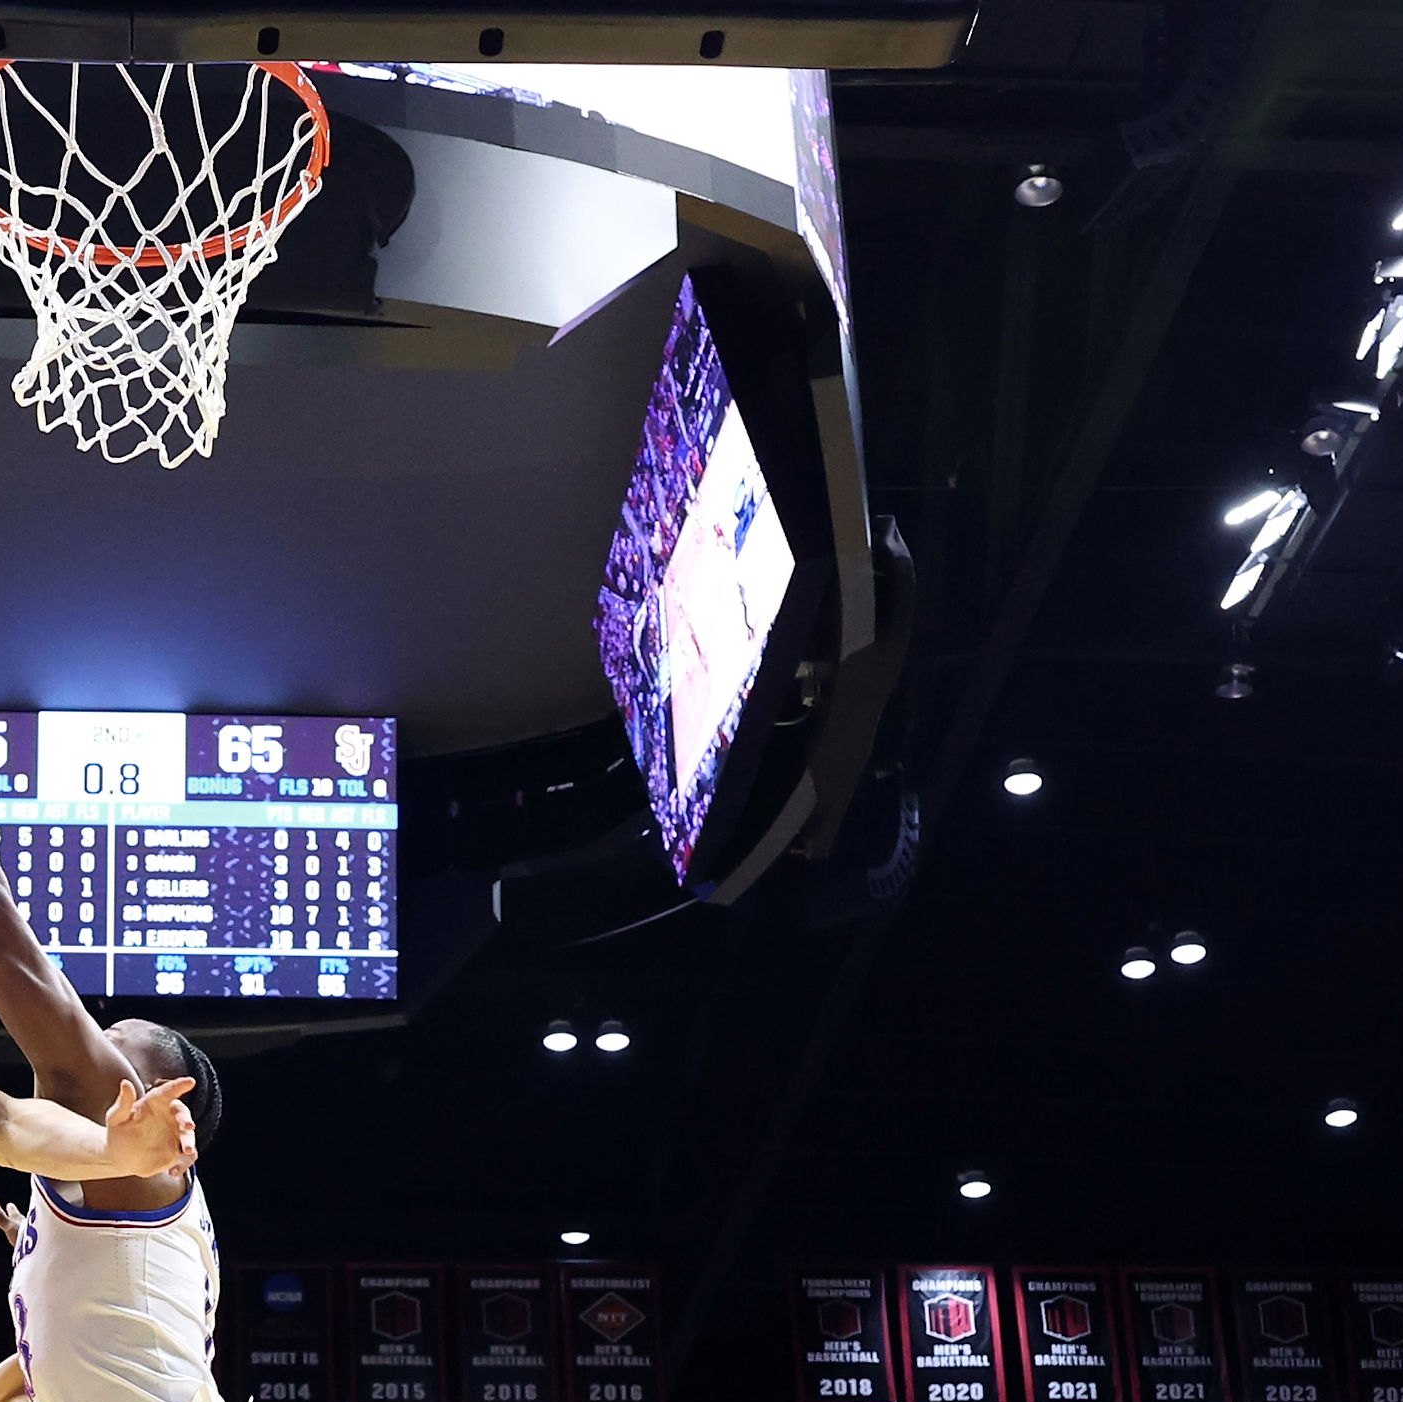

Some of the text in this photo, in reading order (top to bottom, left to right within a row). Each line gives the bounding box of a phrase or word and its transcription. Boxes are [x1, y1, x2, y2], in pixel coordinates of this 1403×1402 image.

[218, 724, 284, 774] 65
[83, 763, 140, 795] 0.8
[187, 777, 244, 796] BONUS
[279, 778, 309, 797] FLS
[337, 779, 368, 798] TOL
[18, 827, 33, 847] 5
[274, 830, 289, 850] 0
[305, 831, 318, 851] 1
[335, 831, 350, 851] 4
[367, 831, 382, 851] 0
[49, 852, 64, 873] 0
[80, 852, 95, 873] 0
[305, 855, 320, 876] 0
[337, 856, 350, 876] 1
[80, 876, 94, 897] 1
[305, 880, 320, 901] 0
[336, 881, 351, 901] 0
[48, 902, 63, 923] 0
[79, 902, 94, 923] 0
[305, 905, 319, 925] 7
[337, 906, 350, 926] 1
[49, 927, 61, 946] 1
[911, 1279, 983, 1292] CHAMPIONS
[806, 1351, 881, 1364] BASKETBALL
[933, 1343, 973, 1356] MEN'S
[1051, 1344, 1088, 1355] MEN'S
[916, 1355, 991, 1369] BASKETBALL
[1033, 1354, 1107, 1367] BASKETBALL
[259, 1382, 312, 1400] 2014
[371, 1382, 427, 1400] 2015
[483, 1384, 538, 1402] 2016
[589, 1384, 644, 1402] 2016
[818, 1377, 874, 1397] 2018
[927, 1382, 985, 1402] 2020
[1047, 1380, 1099, 1401] 2021
[1155, 1382, 1206, 1401] 2021
[1265, 1384, 1318, 1402] 2023
